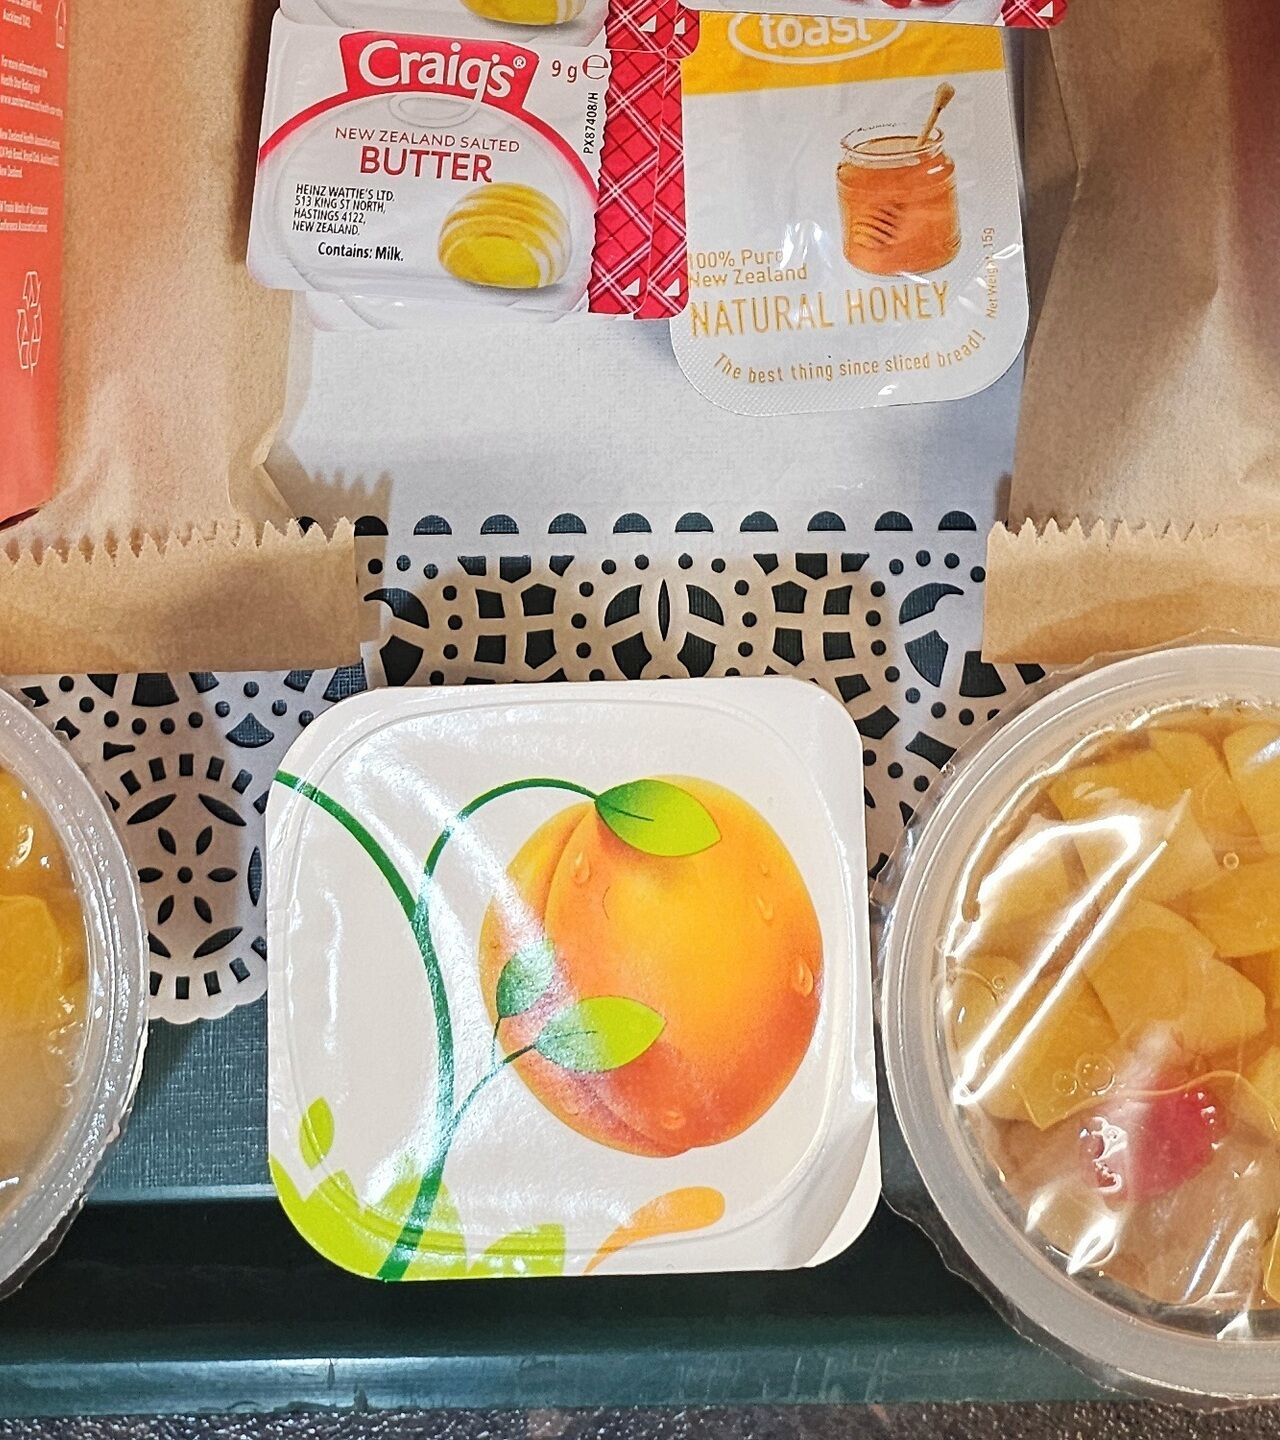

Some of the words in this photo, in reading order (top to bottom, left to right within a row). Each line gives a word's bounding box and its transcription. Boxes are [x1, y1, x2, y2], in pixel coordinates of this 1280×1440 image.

[359, 40, 515, 104] Craig's
[551, 60, 562, 78] 9
[566, 65, 578, 83] g
[583, 91, 599, 154] PX87408/H
[335, 127, 375, 141] NEW
[378, 130, 456, 148] ZEALAND
[460, 136, 520, 153] SALTED
[360, 146, 492, 183] BUTTER
[295, 196, 312, 208] 513
[314, 197, 339, 210] KING
[340, 199, 352, 210] ST
[353, 200, 386, 214] NORTH,
[296, 184, 326, 197] HEINZ
[328, 186, 374, 200] WATTIE'S
[375, 190, 395, 202] LTD.
[292, 221, 315, 233] NEW
[316, 222, 360, 236] ZEALAND.
[294, 208, 340, 222] HASTINGS
[341, 211, 366, 225] 4122,
[318, 242, 373, 260] Contains:
[375, 245, 404, 261] Milk.
[741, 248, 784, 266] Pure
[689, 272, 727, 288] New
[733, 263, 807, 285] Zealand
[690, 292, 834, 337] NATURAL
[847, 279, 950, 326] HONEY
[713, 353, 741, 380] The
[749, 366, 783, 384] best
[791, 364, 833, 381] thing
[839, 359, 879, 377] since
[886, 354, 930, 373] sliced
[936, 329, 988, 368] bread!
